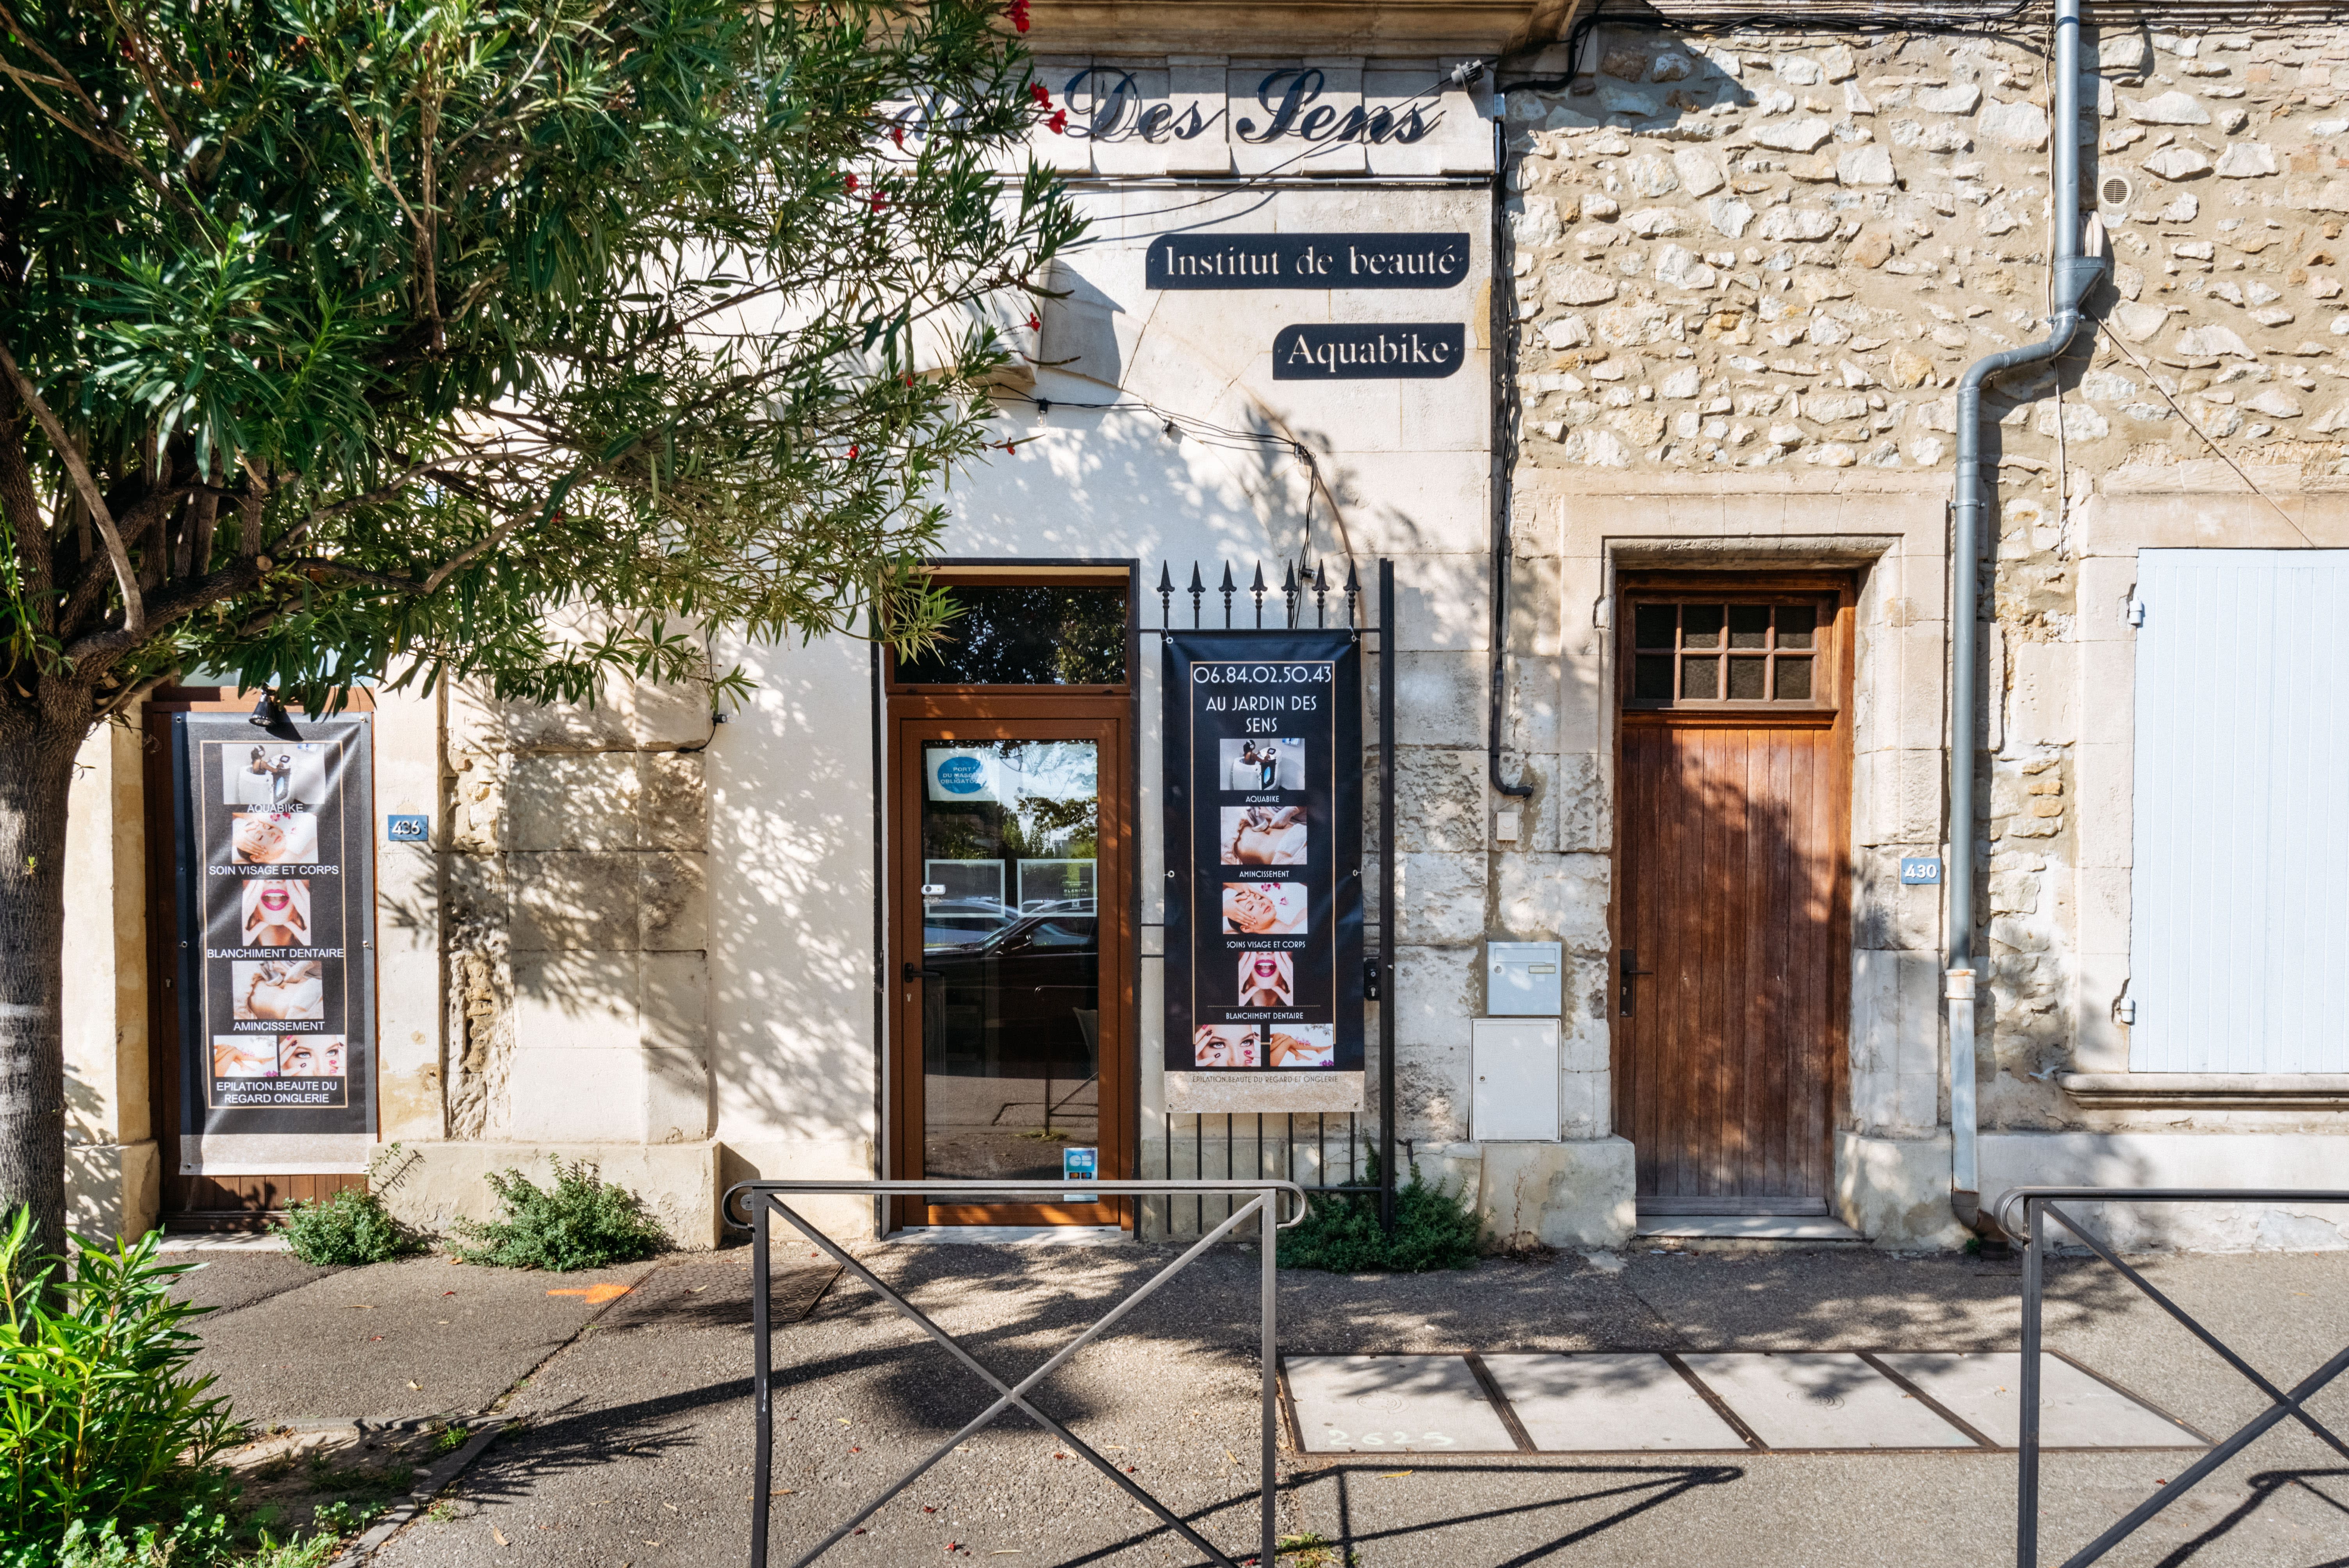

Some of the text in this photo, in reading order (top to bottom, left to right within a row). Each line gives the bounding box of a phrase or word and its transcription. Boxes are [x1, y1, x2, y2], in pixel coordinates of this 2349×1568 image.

[1064, 66, 1227, 144] Des
[1235, 68, 1446, 144] Sens
[1164, 244, 1455, 275] Institut de beauté
[1288, 334, 1449, 373] Aquabike
[1193, 666, 1332, 683] 06.84.02.50.43
[1206, 695, 1317, 711] AU JARDIN DES
[1246, 717, 1278, 732] SENS
[247, 803, 303, 813] AQUABIKE
[392, 820, 421, 835] 436
[209, 865, 339, 875] SOIN VISAGE ET CORPS
[1905, 864, 1937, 878] 430
[207, 948, 344, 958] BLANCHIMENT DENTAIRE
[233, 1021, 325, 1031] AMINCISSEMENT
[322, 1082, 337, 1091] DU
[225, 1094, 329, 1103] REGARD ONGLERIE
